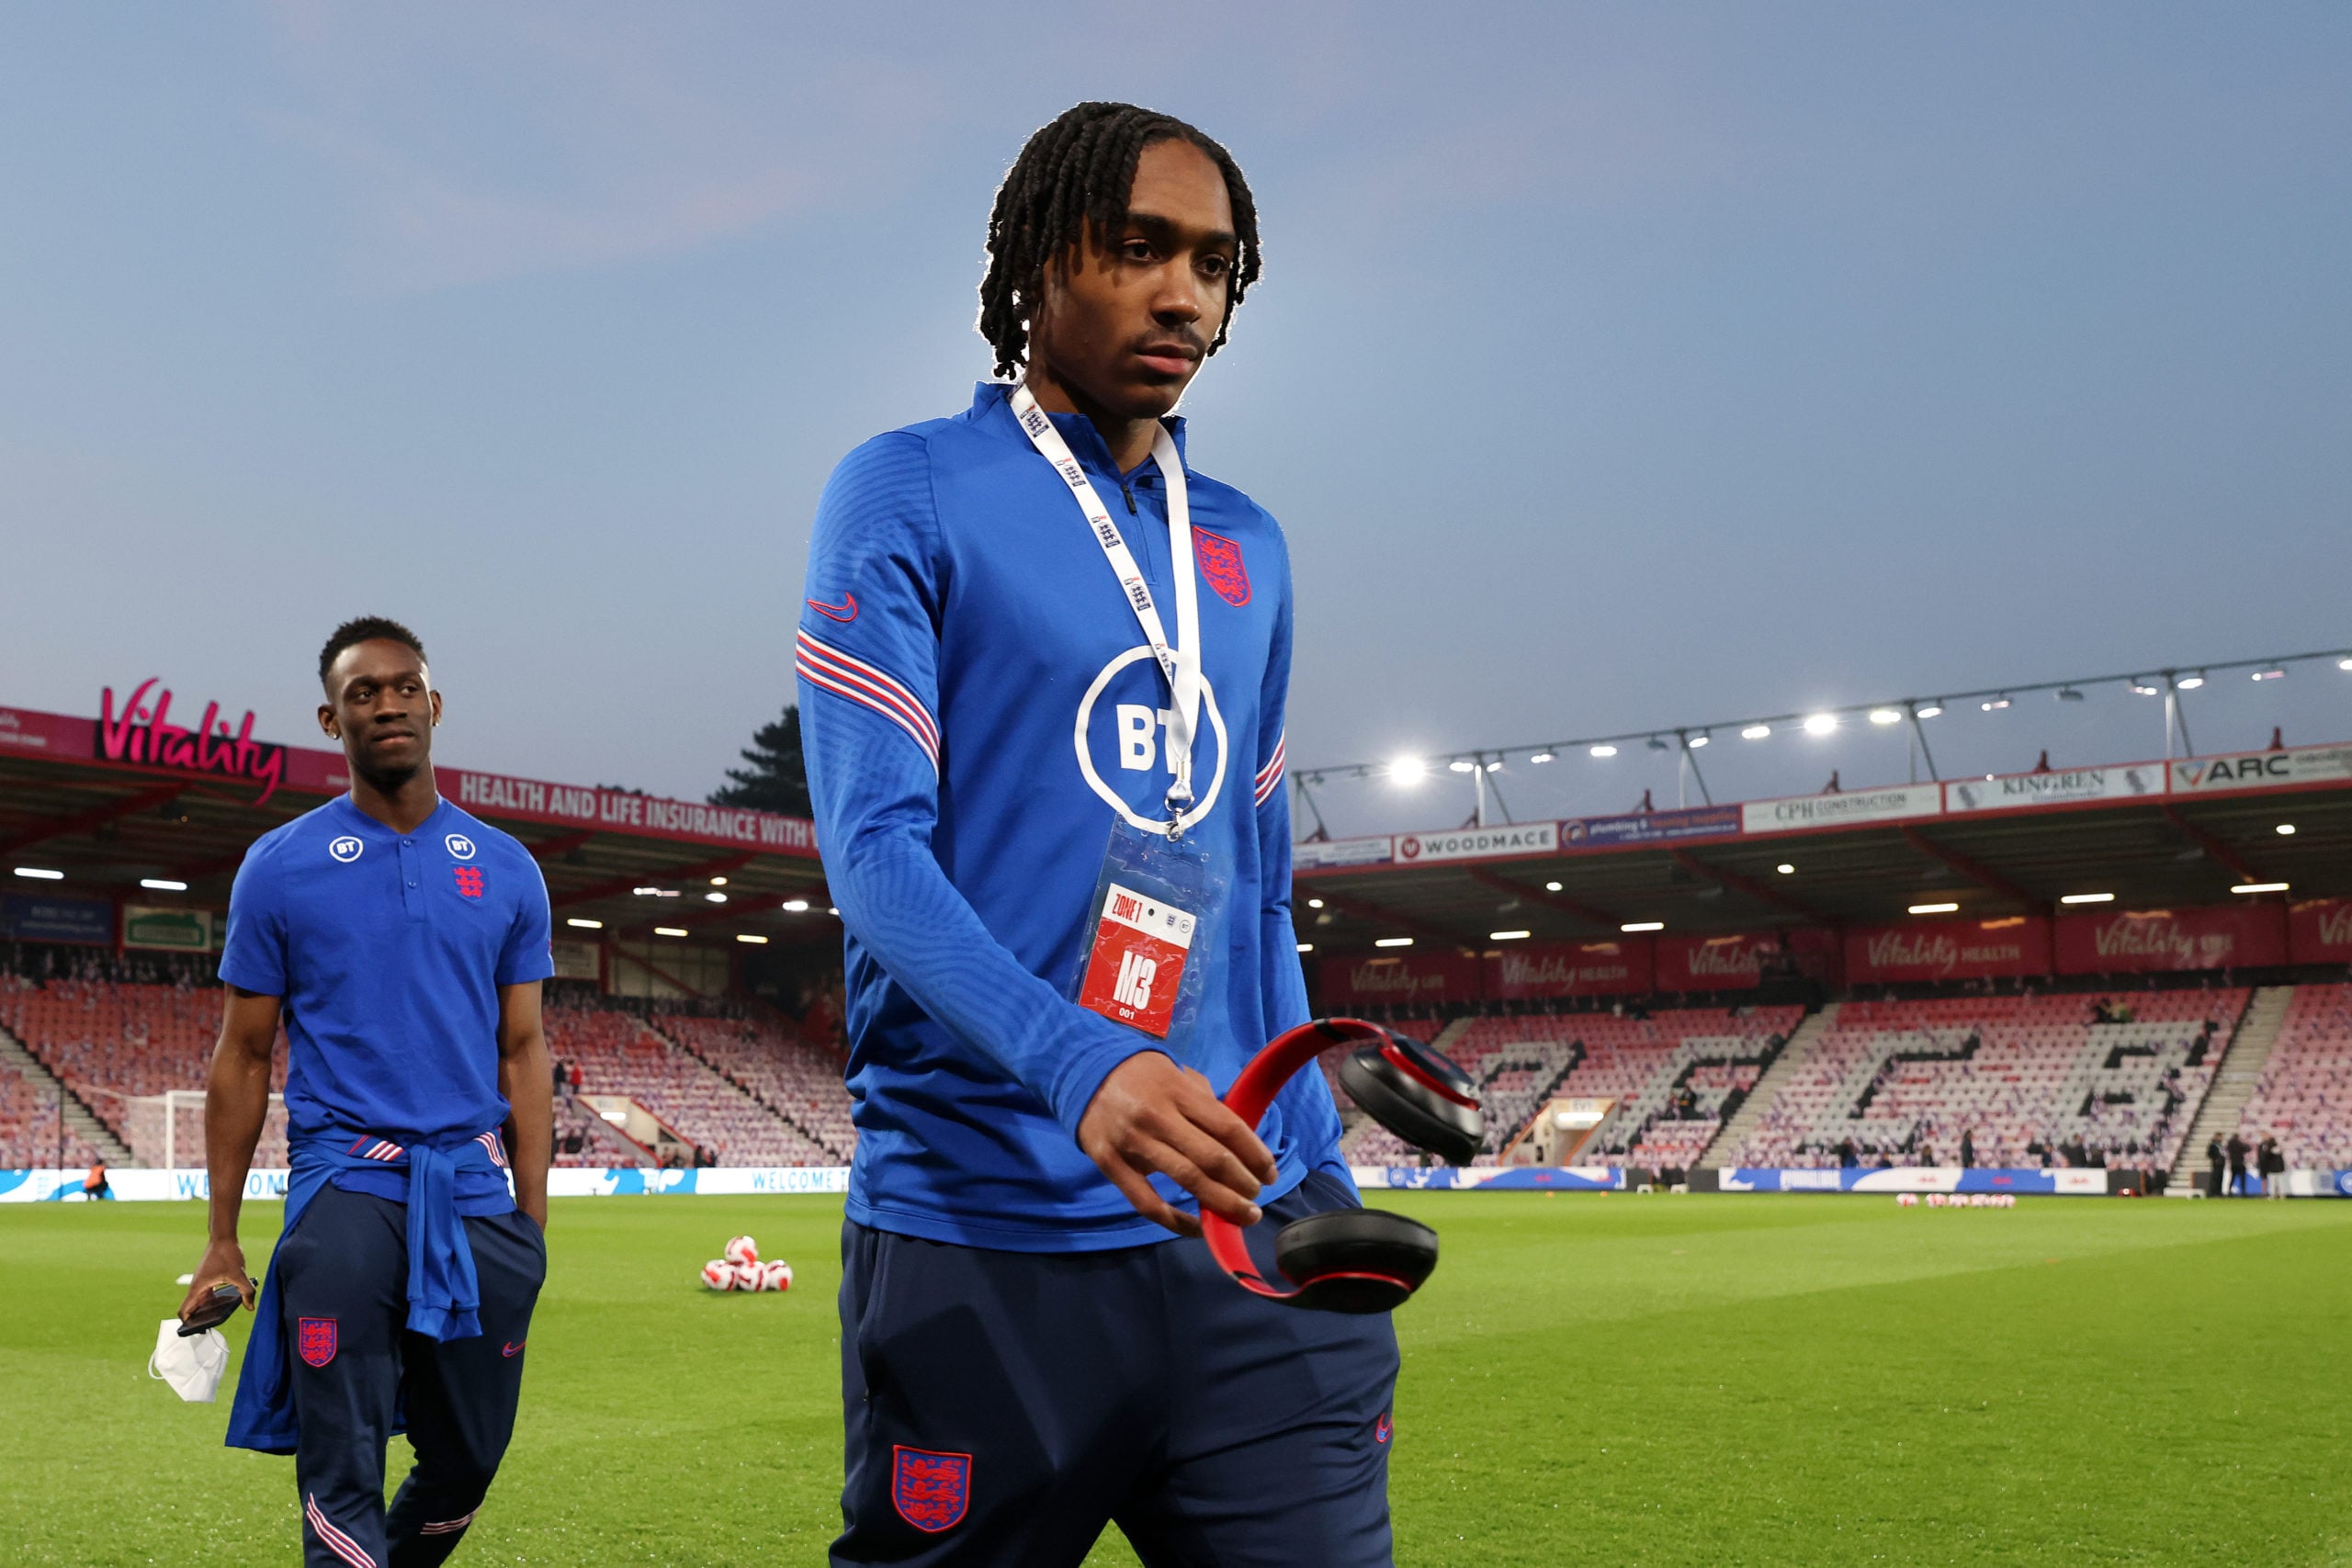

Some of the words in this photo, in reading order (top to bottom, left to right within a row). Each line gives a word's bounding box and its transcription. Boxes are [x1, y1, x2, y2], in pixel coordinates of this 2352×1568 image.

[102, 677, 281, 807] Vitality
[2003, 770, 2105, 795] KINGREN
[2209, 755, 2290, 781] ARC
[460, 774, 545, 812] HEALTH
[549, 787, 595, 818] AND
[601, 795, 640, 827] LIFE
[647, 800, 754, 840] INSURANCE
[760, 816, 807, 847] WITH
[1775, 801, 1815, 821] CPH
[1815, 793, 1907, 811] CONSTRUCTION
[336, 841, 355, 854] BT
[451, 840, 468, 852] BT
[1426, 829, 1550, 853] WOODMACE
[1112, 893, 1138, 920] ZONE
[1136, 902, 1143, 923] 1
[1868, 930, 1957, 975] Vitality
[1962, 945, 2019, 962] HEALTH
[2096, 919, 2193, 959] Vitality
[1688, 939, 1760, 976] Vitalit
[1113, 950, 1157, 1010] M3
[1351, 960, 1419, 998] Vitality
[1501, 953, 1575, 993] Vitality
[1579, 965, 1627, 981] HEALTH
[1119, 1007, 1135, 1020] 001
[177, 1174, 286, 1197] WEOM
[752, 1171, 833, 1190] WELCOME
